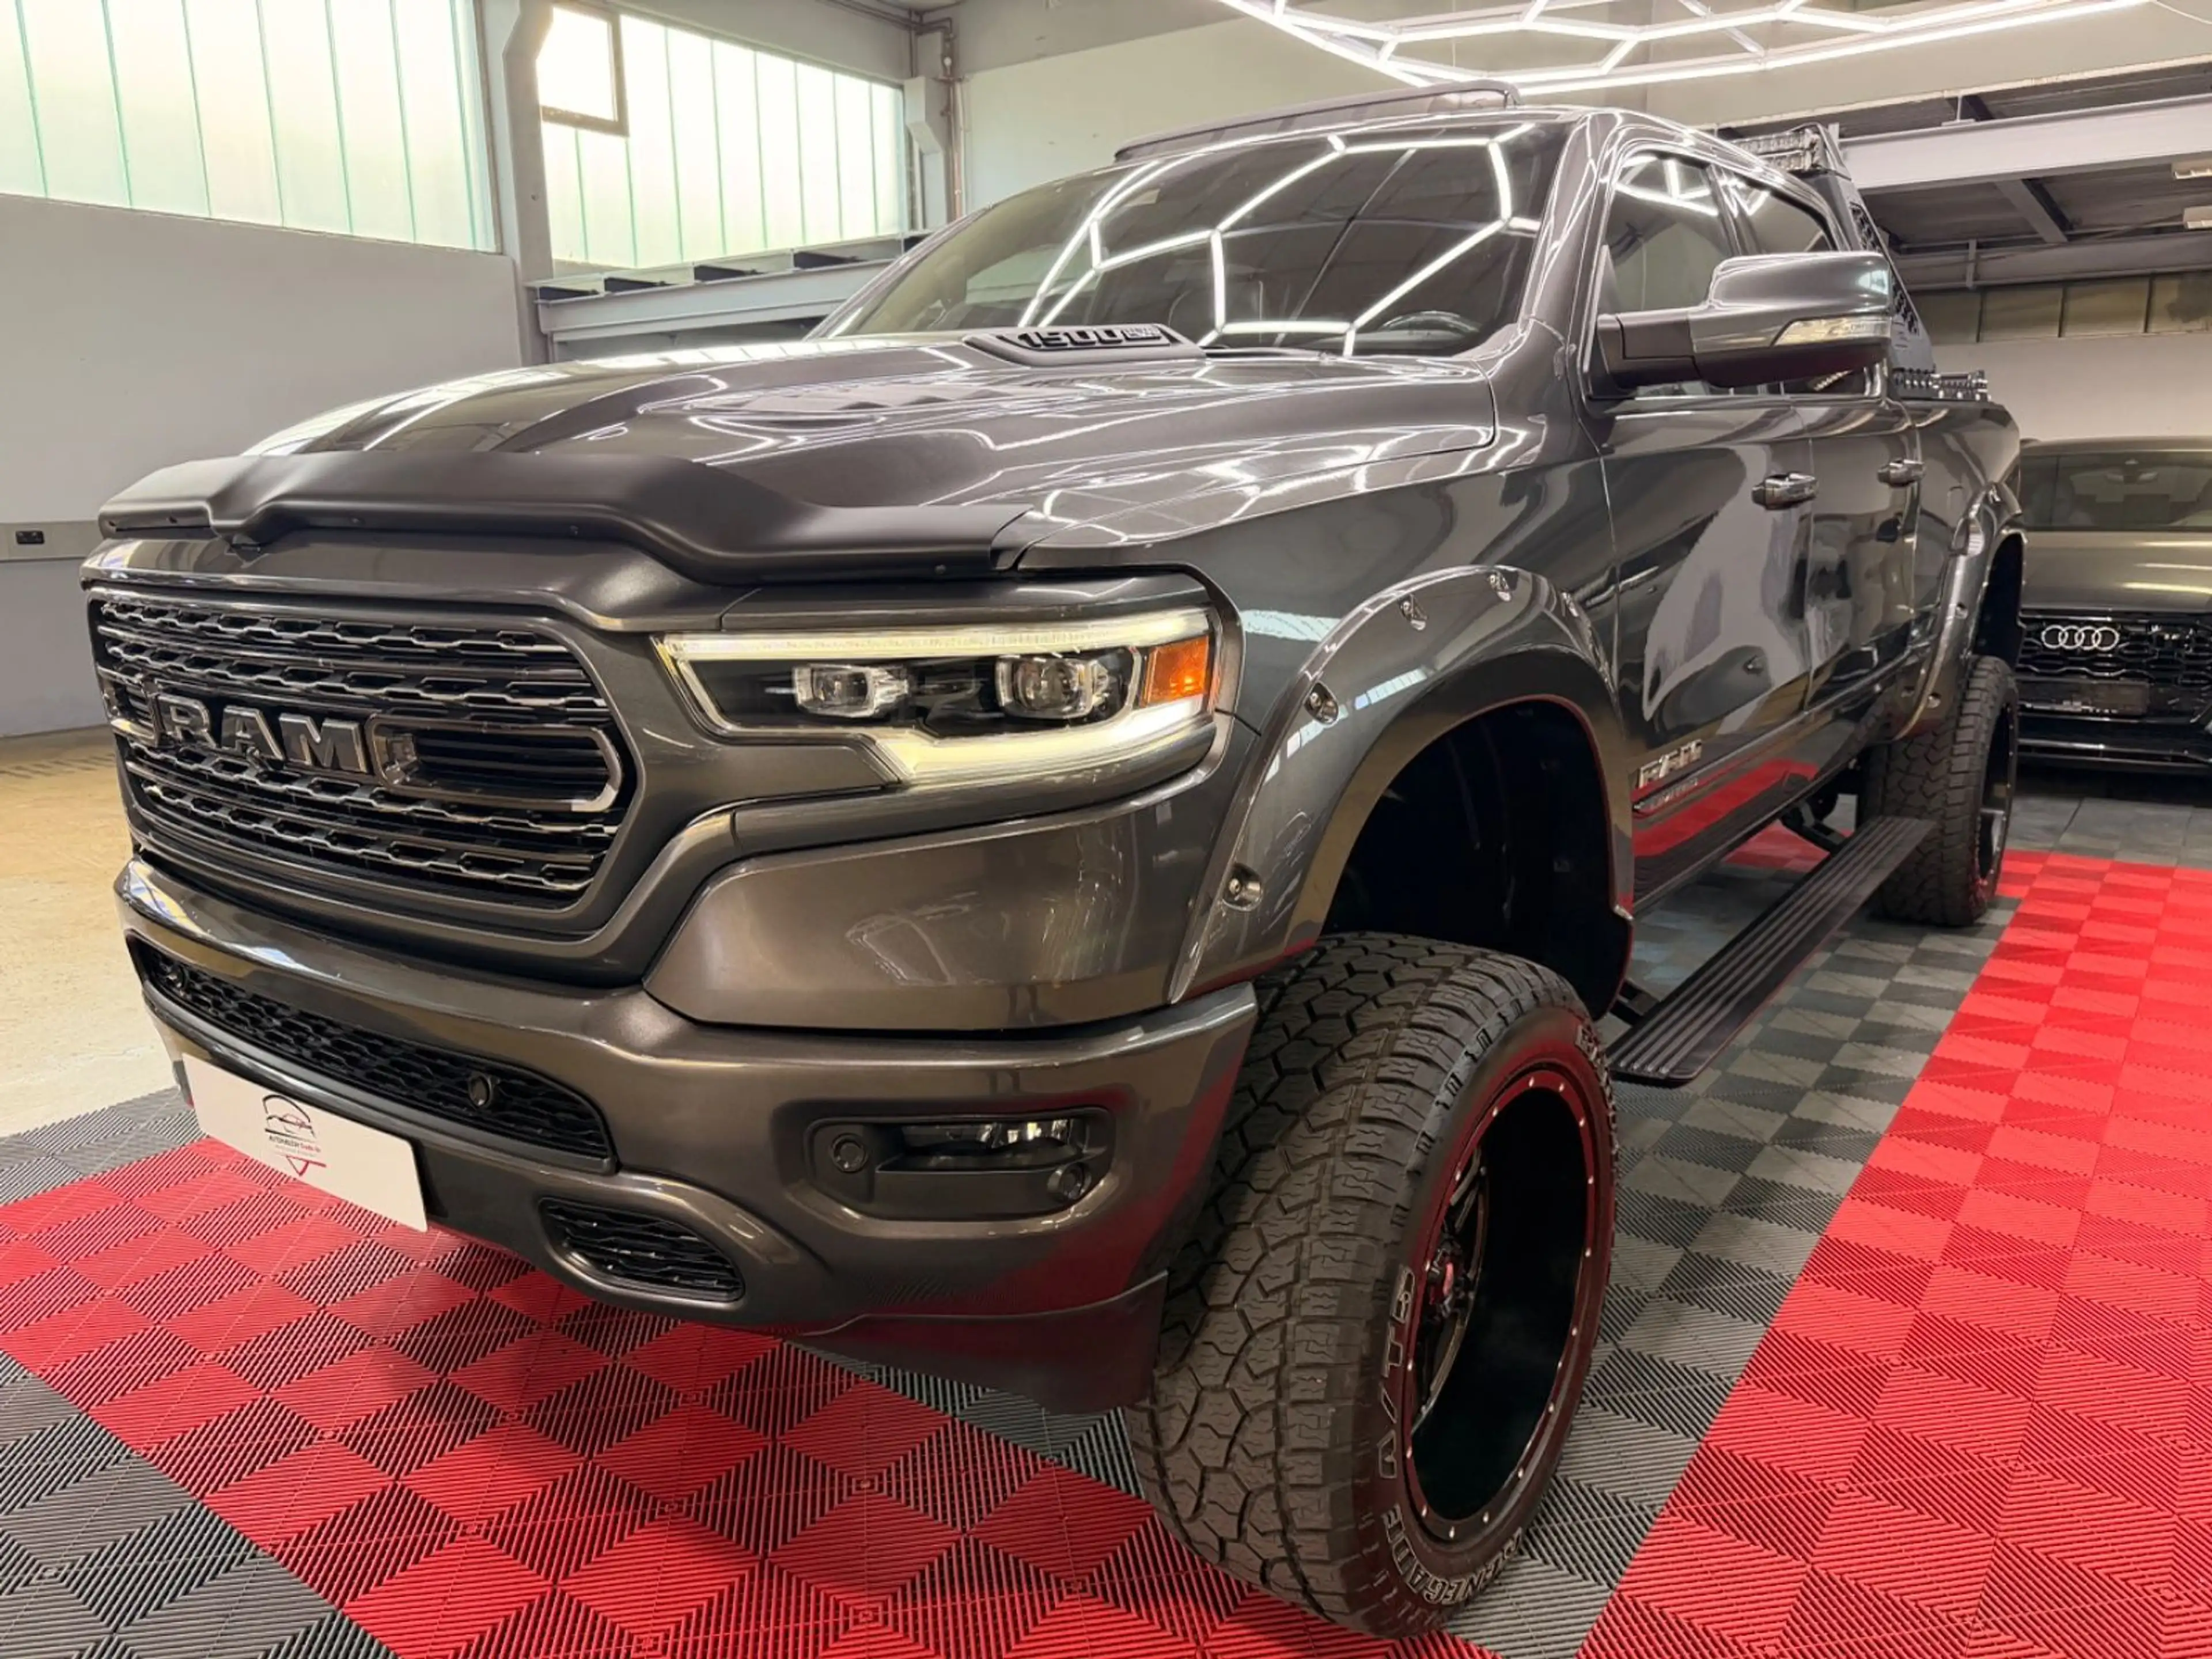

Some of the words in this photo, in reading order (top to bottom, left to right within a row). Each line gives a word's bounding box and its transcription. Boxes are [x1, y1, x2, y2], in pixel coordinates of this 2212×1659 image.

[1018, 329, 1123, 348] 1500
[151, 692, 368, 774] RAM
[1381, 1503, 1522, 1605] RENEGADE
